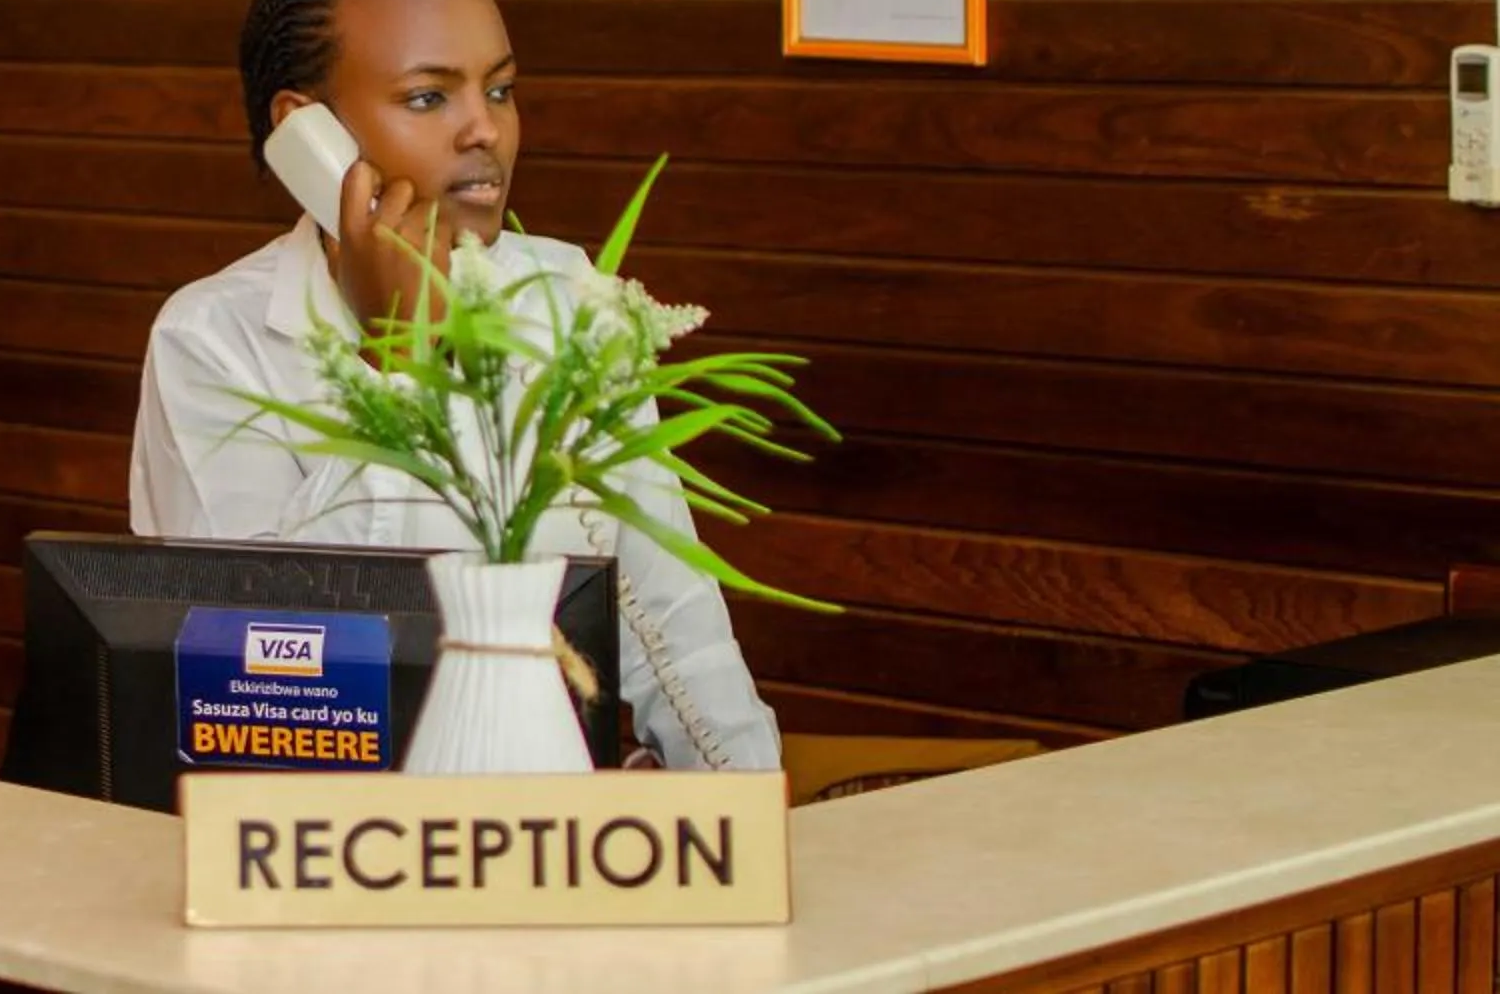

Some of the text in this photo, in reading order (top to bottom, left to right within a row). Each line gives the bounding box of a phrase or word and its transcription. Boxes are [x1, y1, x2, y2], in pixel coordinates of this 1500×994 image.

[259, 638, 312, 660] VISA
[230, 680, 338, 698] Ekkirizibwa wano
[193, 699, 378, 726] Sasuza Visa card yo ku
[193, 722, 380, 762] BWEREERE
[238, 816, 734, 890] RECEPTION
